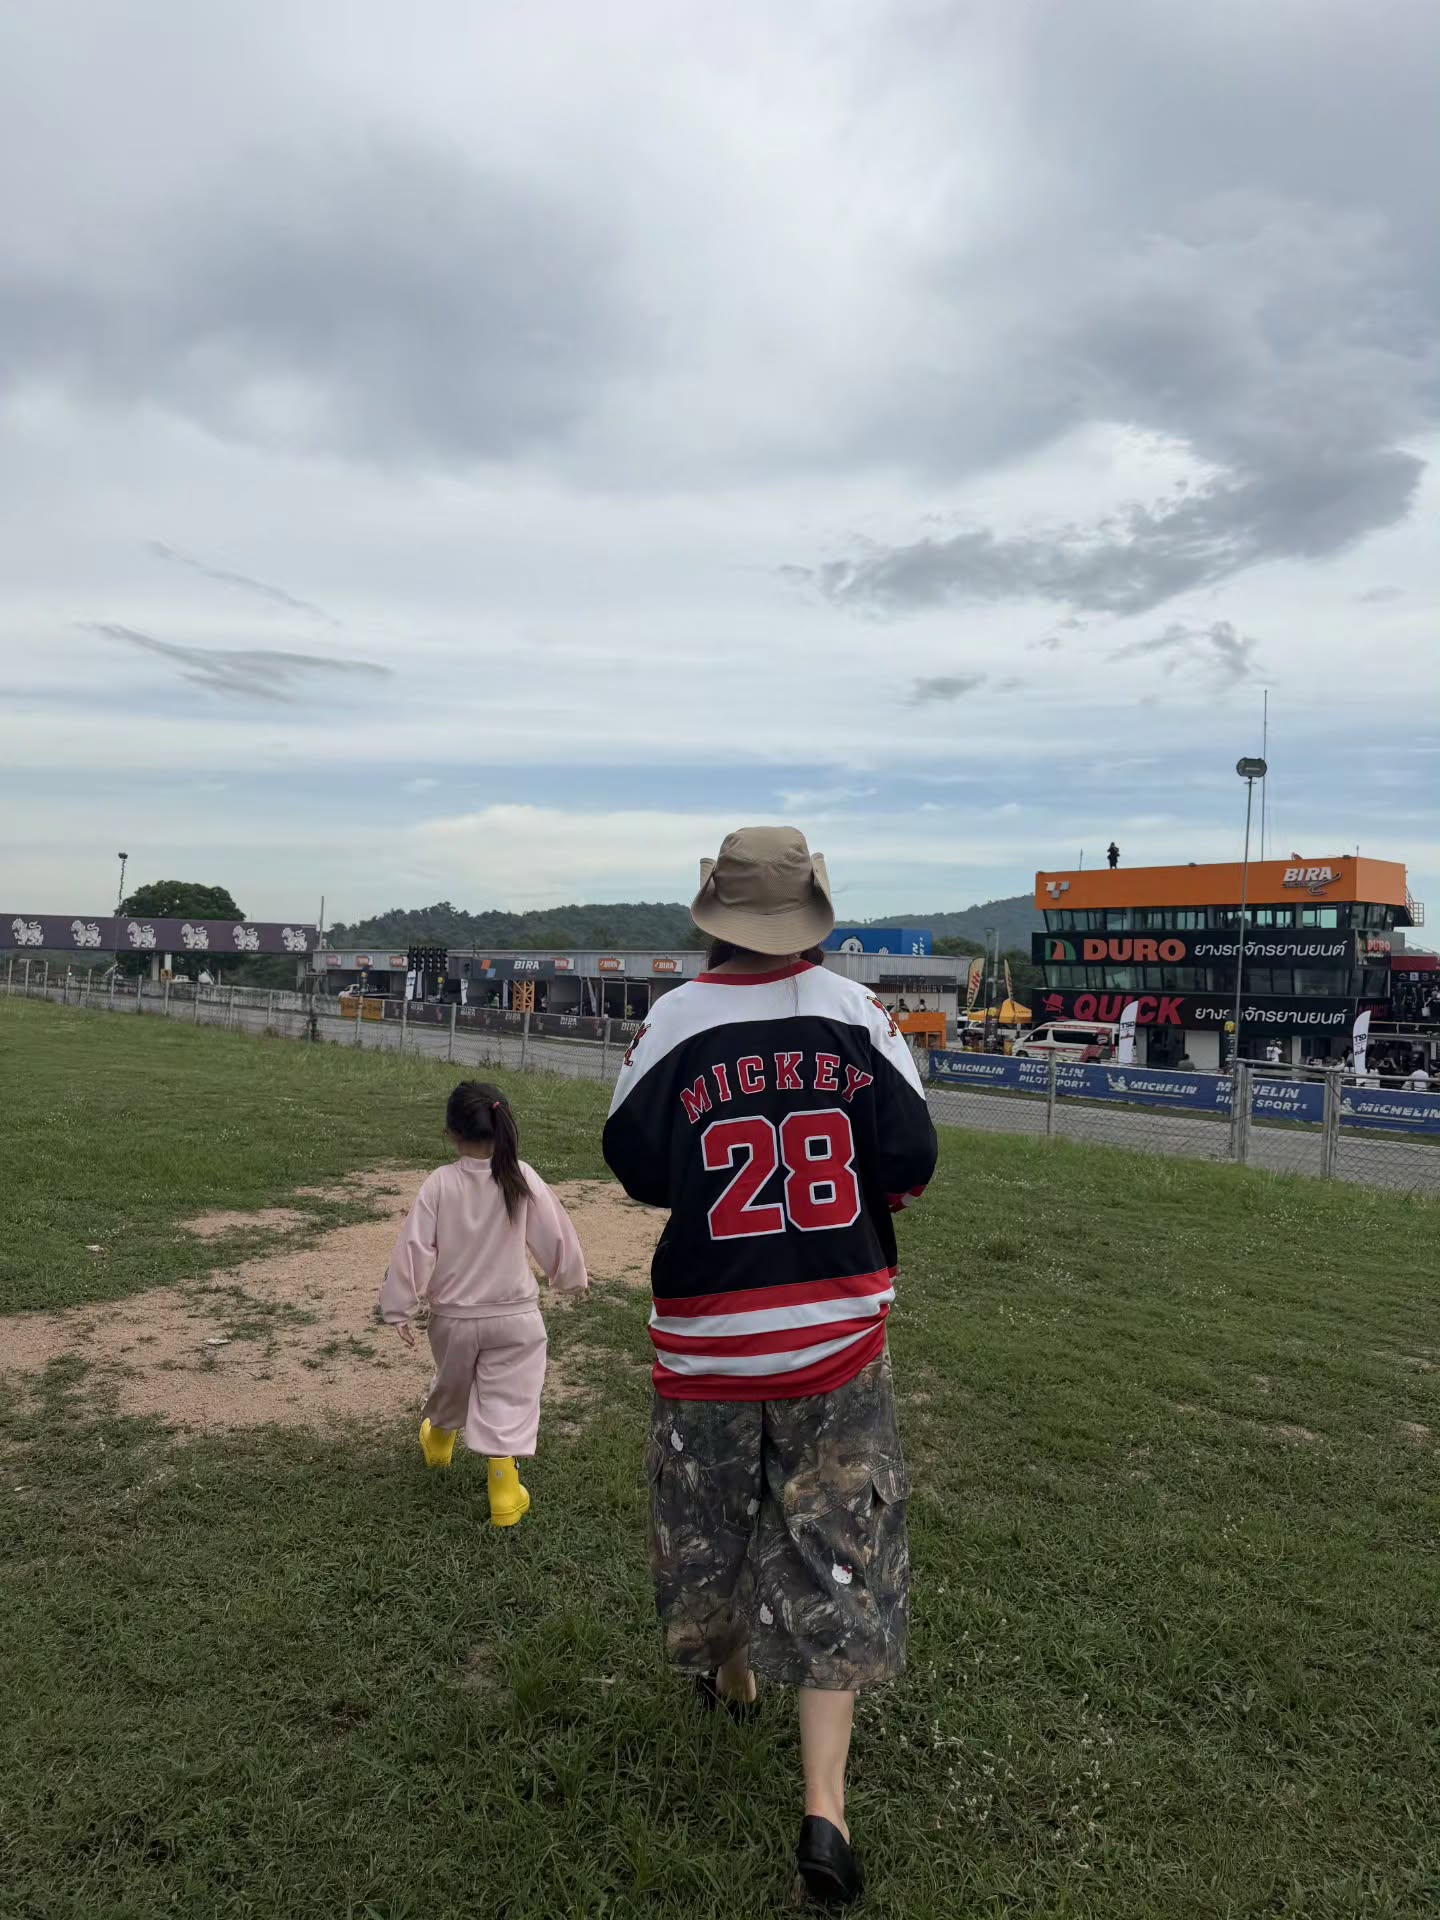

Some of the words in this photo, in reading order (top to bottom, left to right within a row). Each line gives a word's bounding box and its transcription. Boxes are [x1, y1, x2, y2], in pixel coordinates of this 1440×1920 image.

[1282, 867, 1332, 882] BIRA
[1083, 938, 1187, 962] DURO
[1367, 940, 1391, 952] DURO
[513, 961, 540, 970] BIRA
[951, 1063, 1005, 1075] MICHELIN
[679, 1051, 874, 1124] MICKEY
[1130, 1080, 1198, 1095] MICHELIN
[1356, 1102, 1440, 1119] MICHELIN
[700, 1107, 862, 1241] 28
